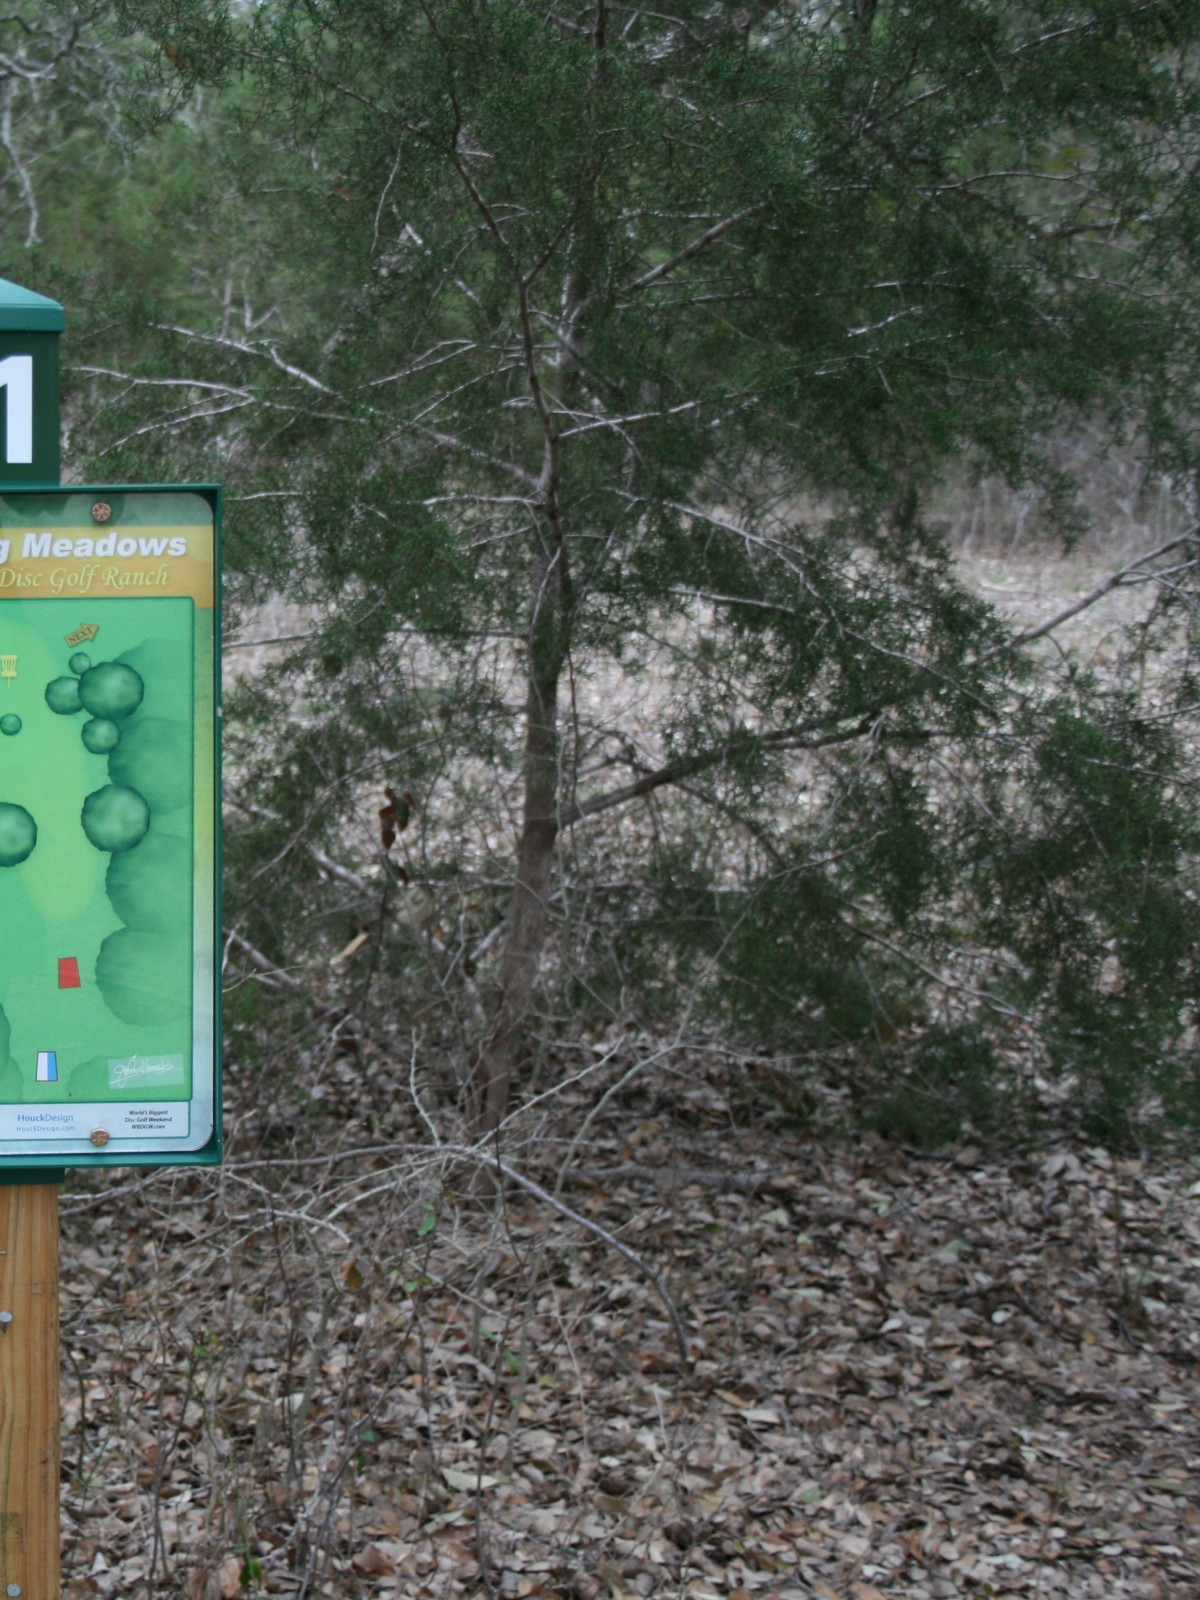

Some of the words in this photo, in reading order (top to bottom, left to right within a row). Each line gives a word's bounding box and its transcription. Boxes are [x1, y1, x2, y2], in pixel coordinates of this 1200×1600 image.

[21, 532, 188, 558] Meadows
[50, 564, 101, 594] Golf
[102, 563, 169, 590] Ranch
[68, 626, 93, 645] NEXT
[17, 1113, 75, 1124] HouckDesign
